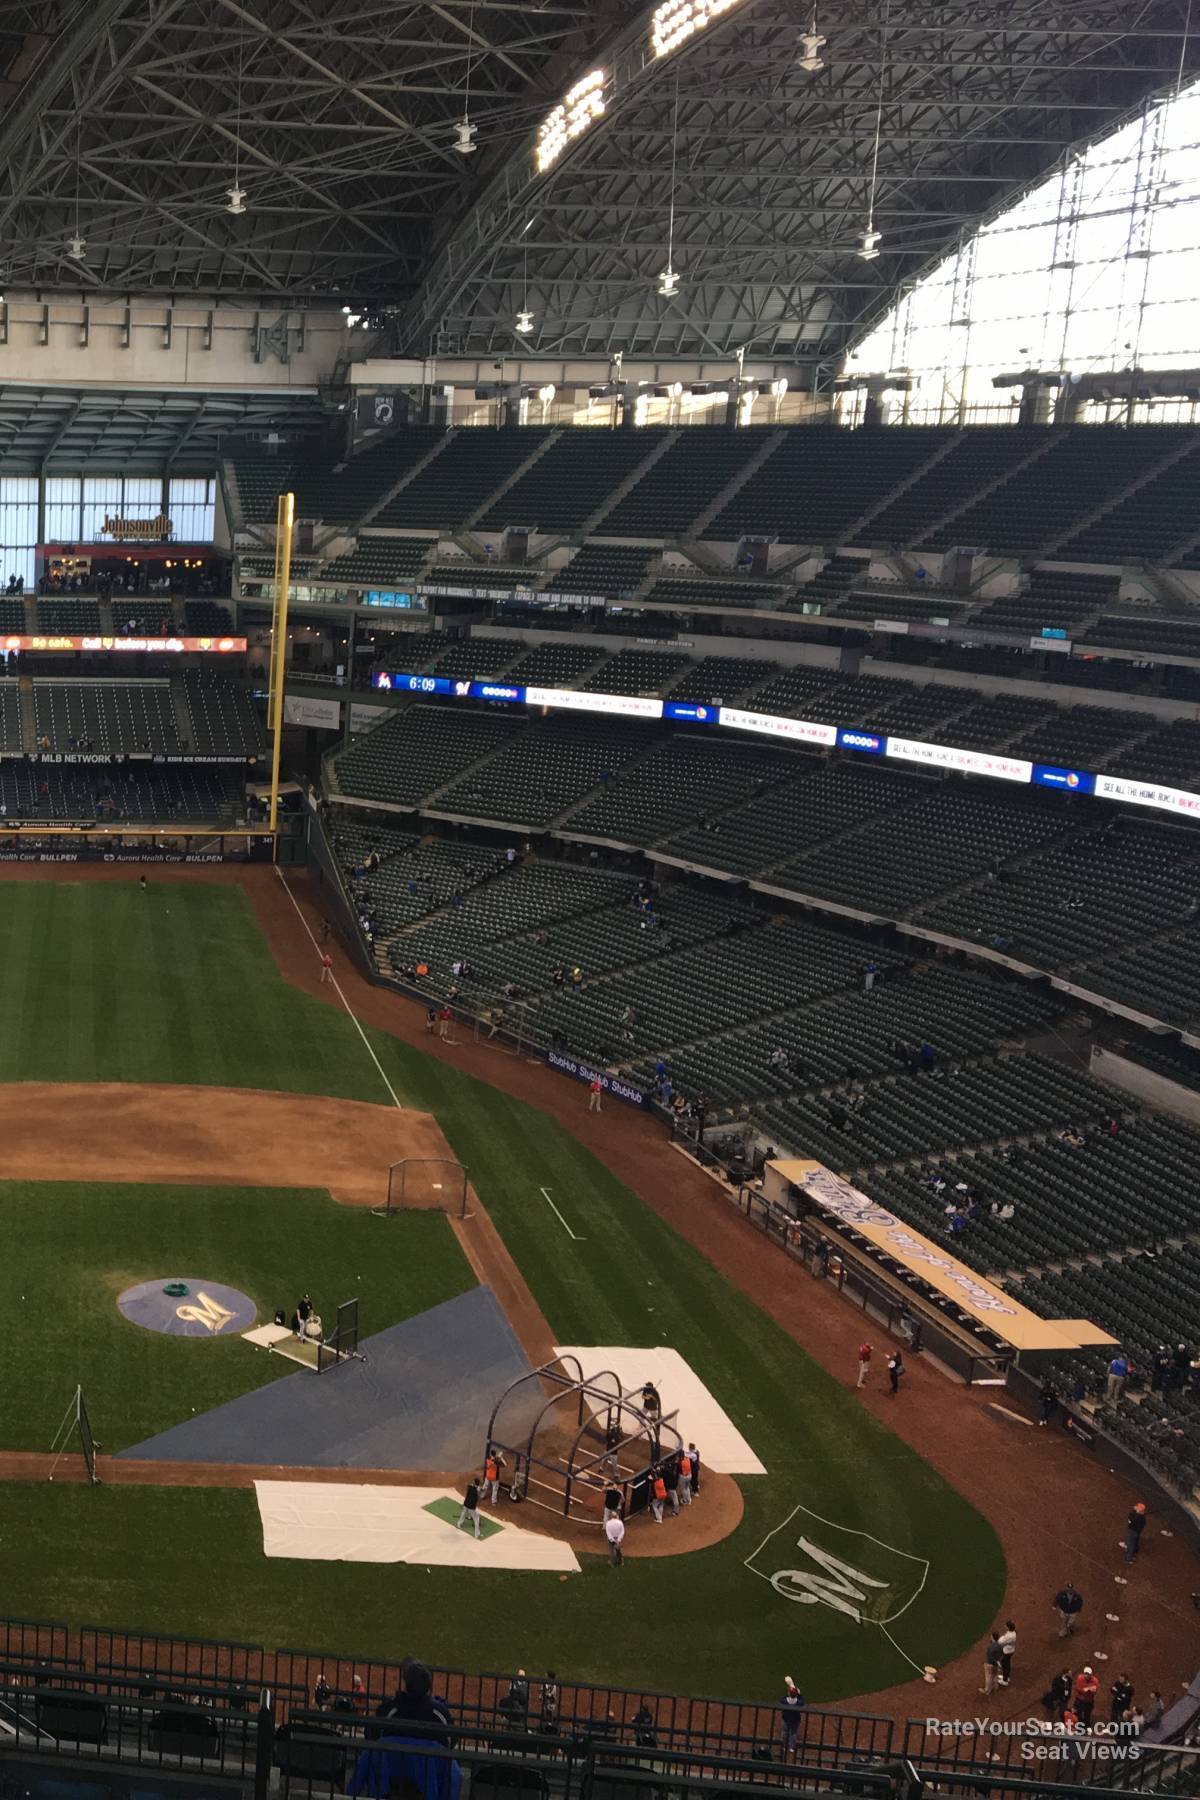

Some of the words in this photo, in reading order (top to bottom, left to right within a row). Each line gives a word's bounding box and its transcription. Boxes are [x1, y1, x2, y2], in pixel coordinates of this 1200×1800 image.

[101, 514, 174, 533] Johnsonville
[410, 677, 436, 691] 6:09
[41, 754, 62, 763] MLB
[64, 754, 111, 763] NETWORK
[20, 853, 36, 861] Care
[116, 854, 139, 862] Aurora
[141, 854, 164, 862] Health
[548, 1052, 577, 1073] StubHub
[580, 1066, 609, 1088] StubHub
[611, 1081, 642, 1104] StubHub
